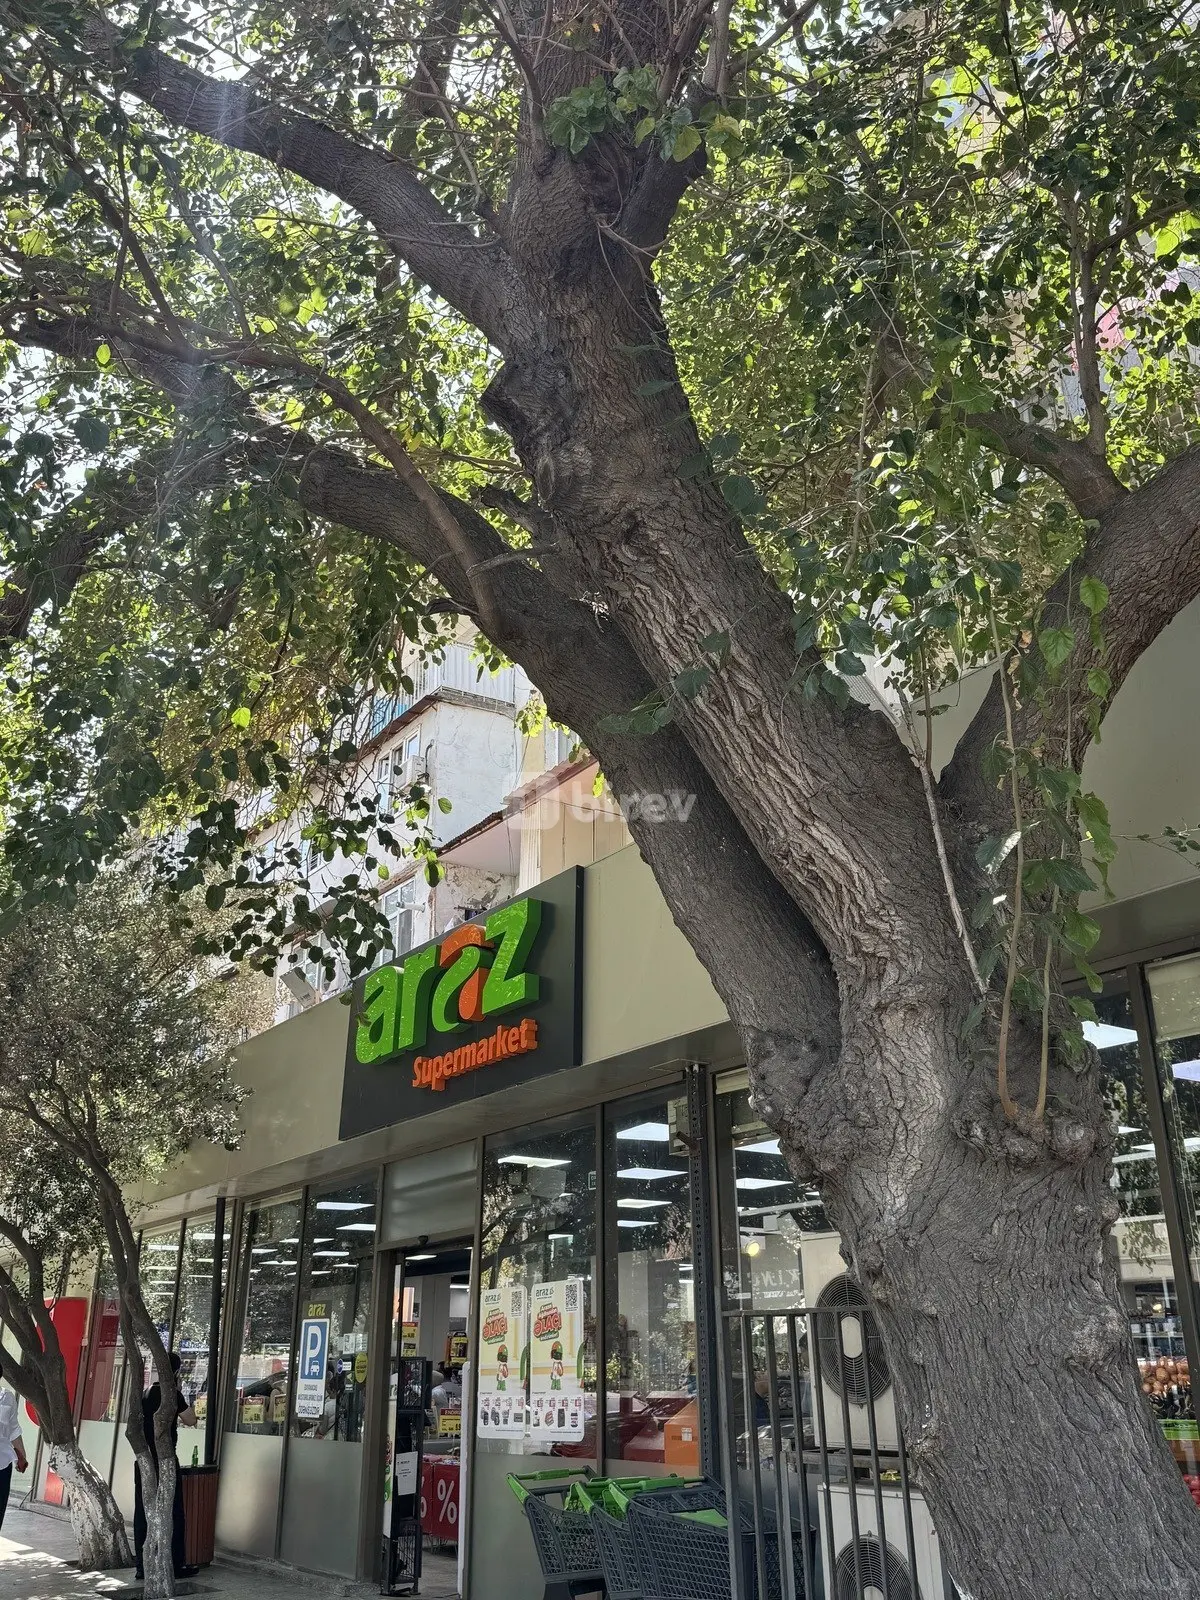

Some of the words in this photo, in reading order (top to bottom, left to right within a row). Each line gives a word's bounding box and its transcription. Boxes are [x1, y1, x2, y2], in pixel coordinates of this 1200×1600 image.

[355, 897, 542, 1064] araz
[412, 1018, 538, 1091] Supermarket
[307, 1303, 326, 1317] araz
[484, 1294, 497, 1303] araz
[535, 1288, 549, 1297] araz
[304, 1325, 322, 1376] P
[437, 1478, 457, 1525] %
